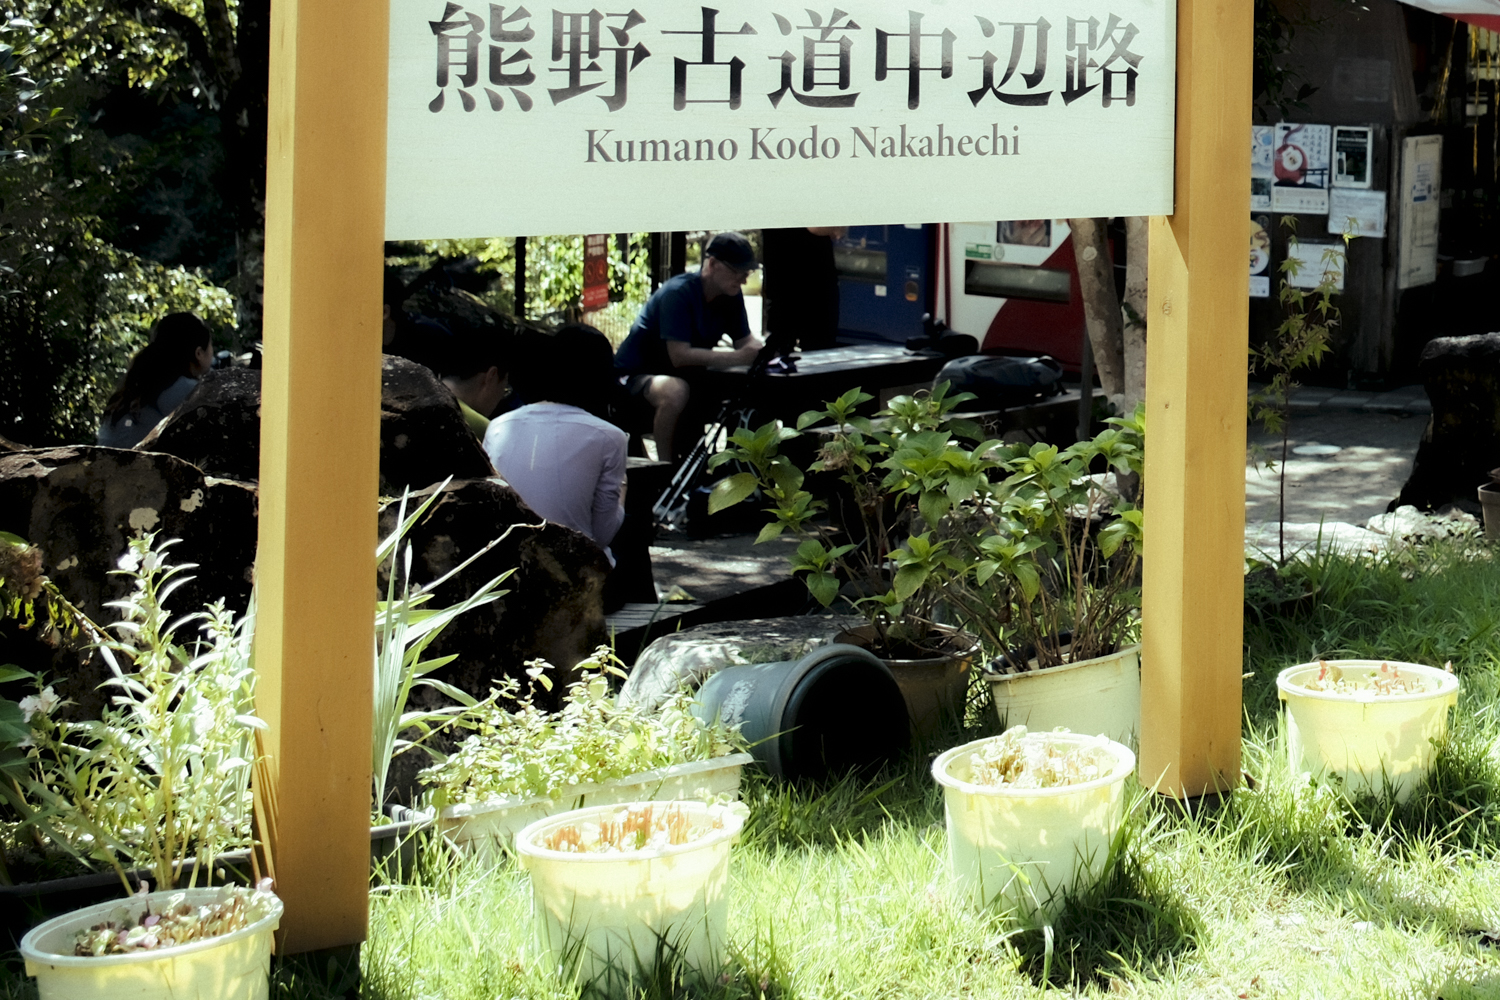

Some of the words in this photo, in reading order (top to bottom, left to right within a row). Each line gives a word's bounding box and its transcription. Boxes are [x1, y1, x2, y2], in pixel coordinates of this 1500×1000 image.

[428, 0, 1145, 113] 熊野古道中辺路
[585, 129, 738, 162] Kumano
[749, 125, 840, 160] Kodo
[850, 122, 1020, 159] Nakahechi
